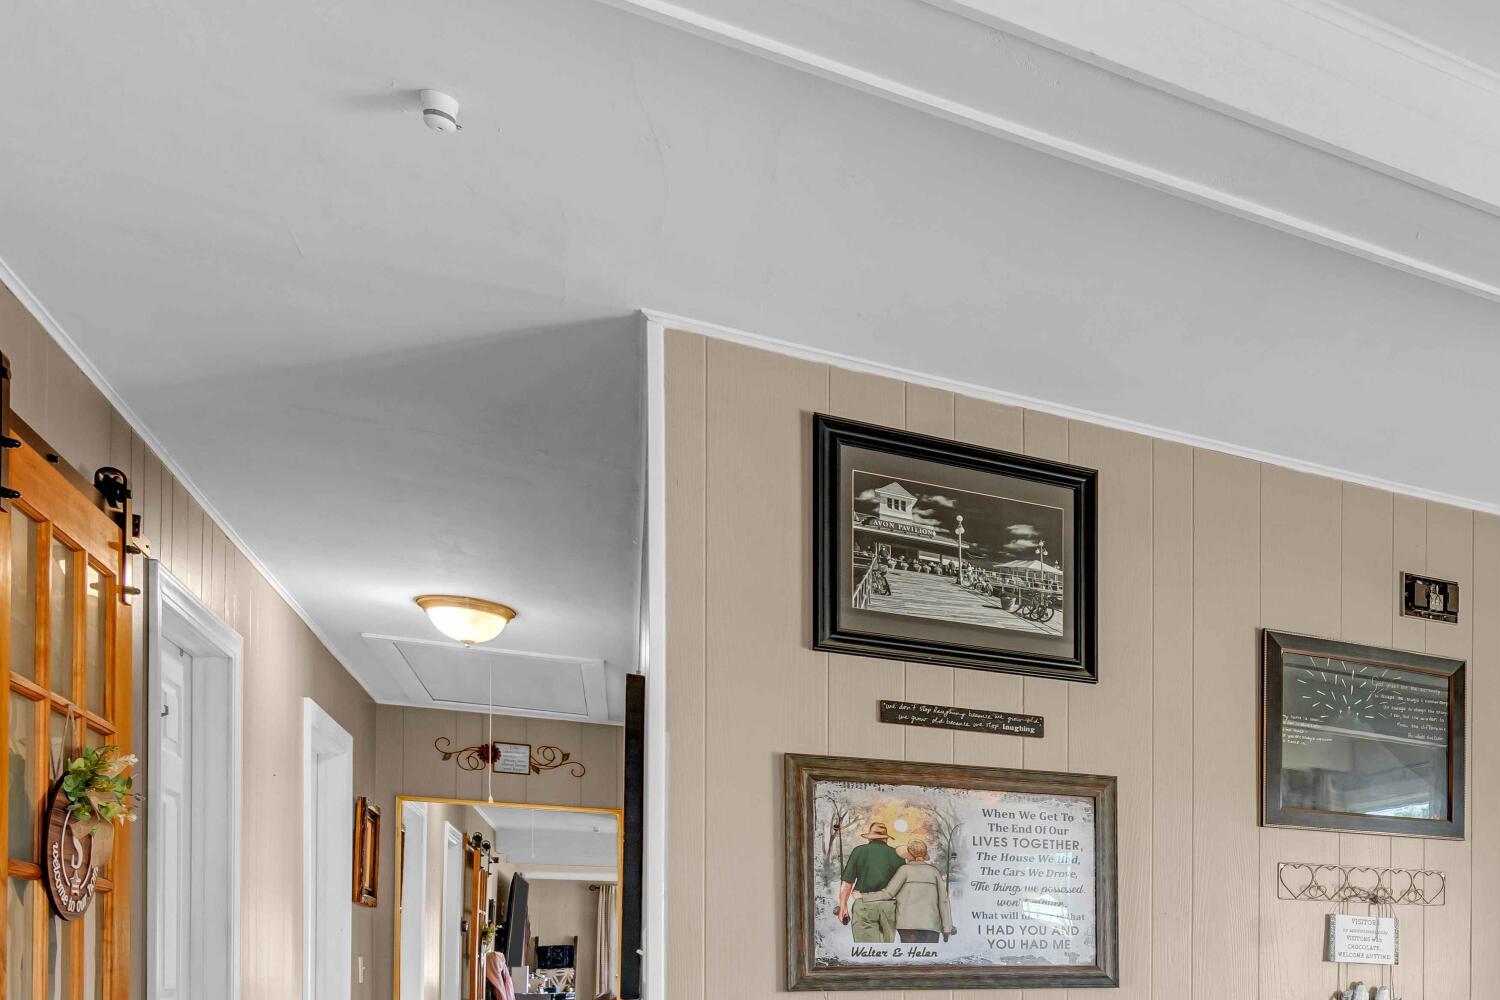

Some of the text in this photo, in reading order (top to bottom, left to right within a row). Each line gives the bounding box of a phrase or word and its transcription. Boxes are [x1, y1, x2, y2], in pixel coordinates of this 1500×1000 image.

[873, 519, 933, 536] AVON PAVILION
[1002, 723, 1036, 734] laughing
[981, 808, 1074, 822] When We Get To
[988, 823, 1070, 836] The End Of Our
[972, 836, 1083, 852] LIVES TOGETHER,
[976, 852, 997, 861] The
[1001, 853, 1035, 863] House
[1038, 854, 1054, 863] We
[980, 866, 1000, 876] The
[1002, 867, 1026, 877] Cars
[1028, 869, 1044, 878] We
[970, 880, 990, 892] The
[992, 881, 1022, 896] things
[971, 911, 998, 920] What
[1001, 911, 1019, 920] will
[986, 925, 1015, 936] HAD
[1019, 925, 1048, 936] YOU
[1051, 926, 1080, 936] AND
[987, 939, 1071, 950] YOU HAD ME
[851, 946, 938, 958] Walter & Helen
